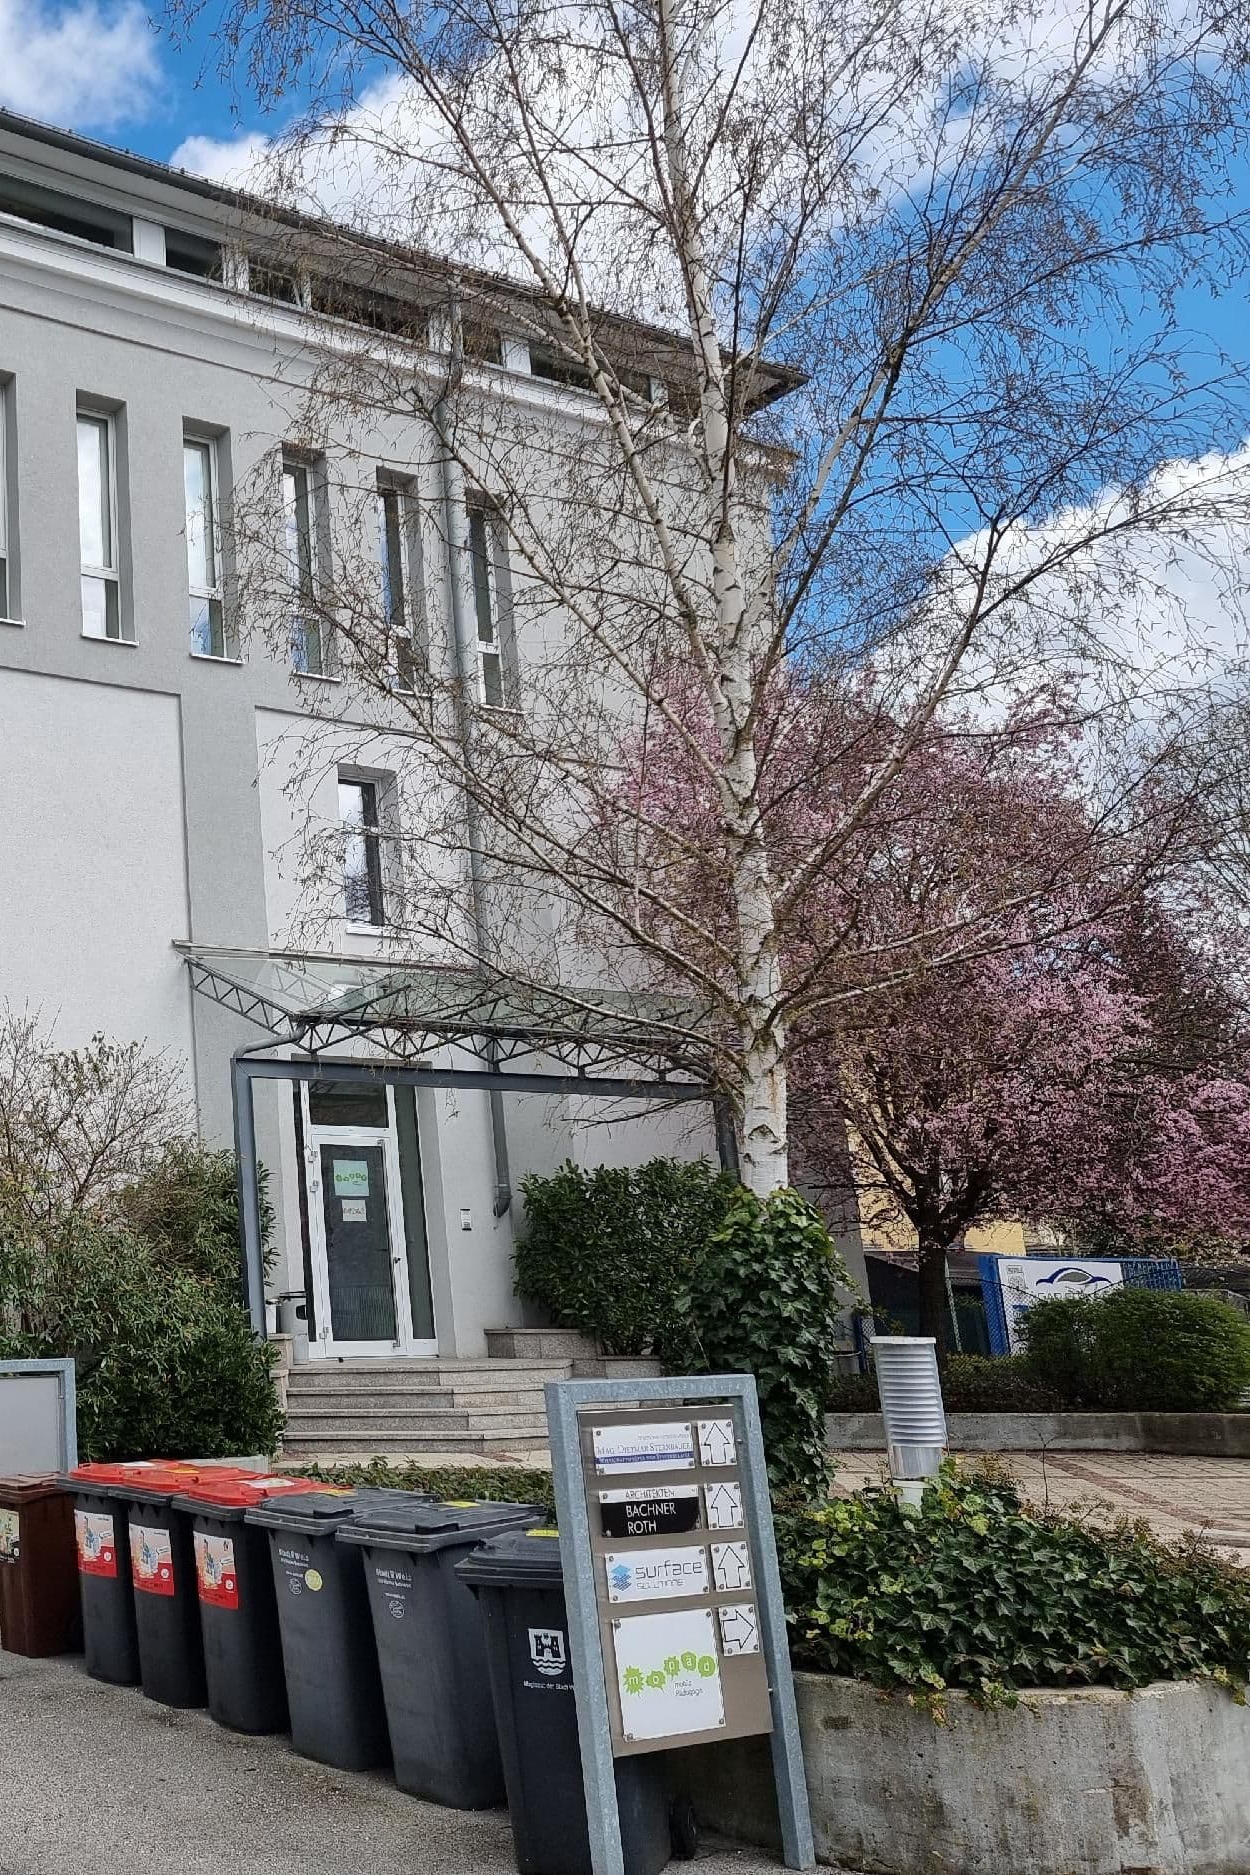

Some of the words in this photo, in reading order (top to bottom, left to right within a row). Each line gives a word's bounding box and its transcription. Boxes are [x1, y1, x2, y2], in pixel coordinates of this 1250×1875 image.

[626, 1488, 674, 1499] ARCHITEKTEN
[626, 1502, 676, 1517] BACHNER
[628, 1520, 657, 1534] ROTH
[635, 1560, 703, 1579] surface
[627, 1655, 712, 1687] mopad
